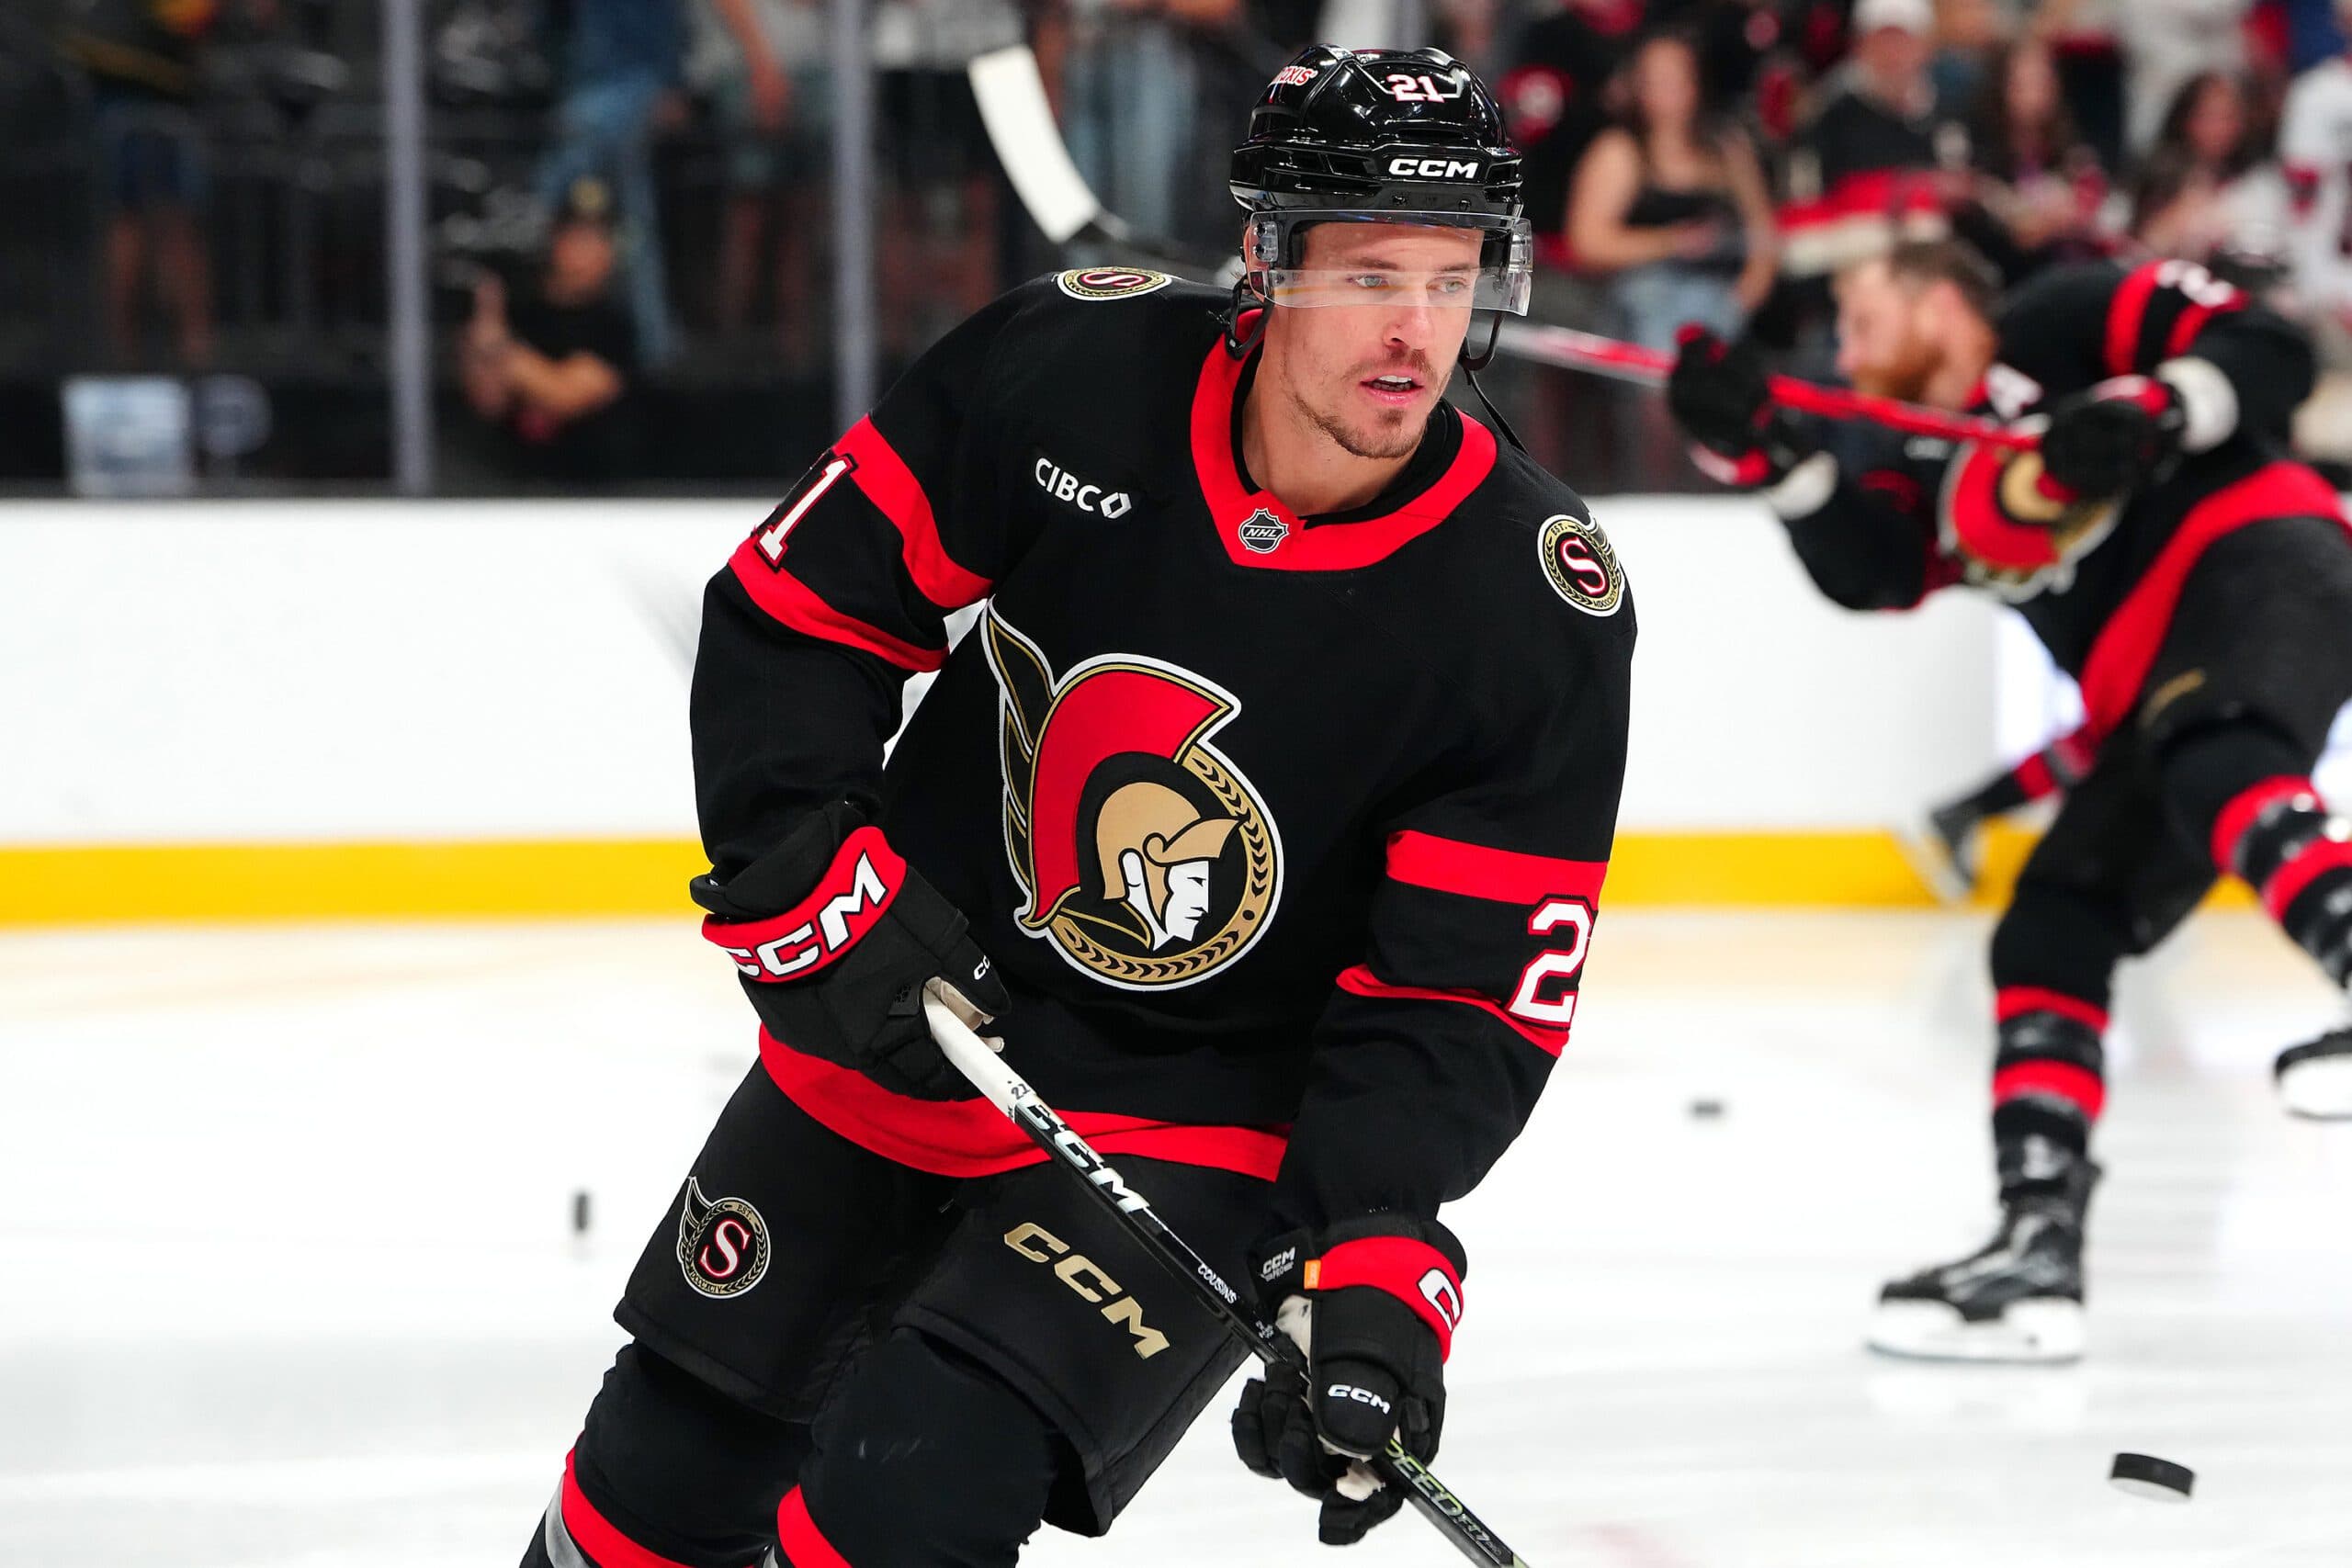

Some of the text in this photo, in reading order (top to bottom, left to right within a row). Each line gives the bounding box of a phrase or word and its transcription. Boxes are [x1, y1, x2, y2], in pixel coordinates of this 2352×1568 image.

[1386, 73, 1445, 104] 21
[1388, 158, 1478, 178] CCM
[1035, 457, 1102, 513] CIBC
[1245, 528, 1277, 537] NHL
[1560, 536, 1606, 595] S
[1011, 1083, 1031, 1100] 21
[1015, 1100, 1150, 1213] CCM
[737, 1202, 752, 1221] EST.
[699, 1218, 751, 1279] S
[1262, 1246, 1296, 1275] CCM
[1004, 1222, 1170, 1359] CCM
[1198, 1263, 1238, 1304] COUSINS
[1328, 1383, 1392, 1415] CCM
